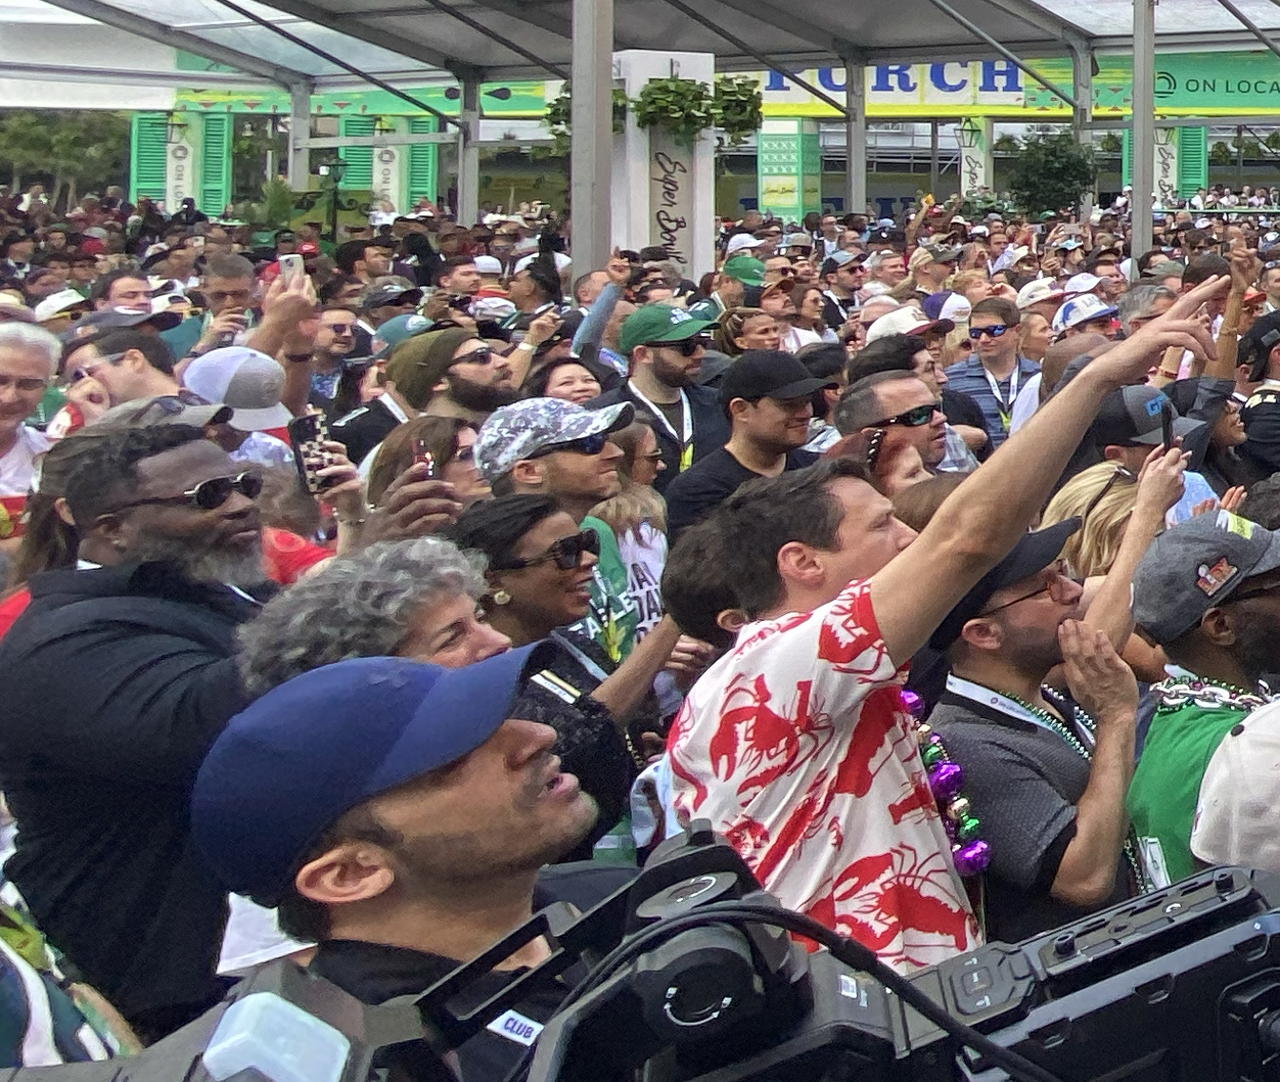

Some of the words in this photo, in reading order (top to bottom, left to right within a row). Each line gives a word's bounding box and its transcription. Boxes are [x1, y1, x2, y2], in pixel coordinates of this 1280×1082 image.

[1185, 78, 1216, 93] ON
[652, 151, 687, 208] Super
[503, 1017, 535, 1039] CLUB
